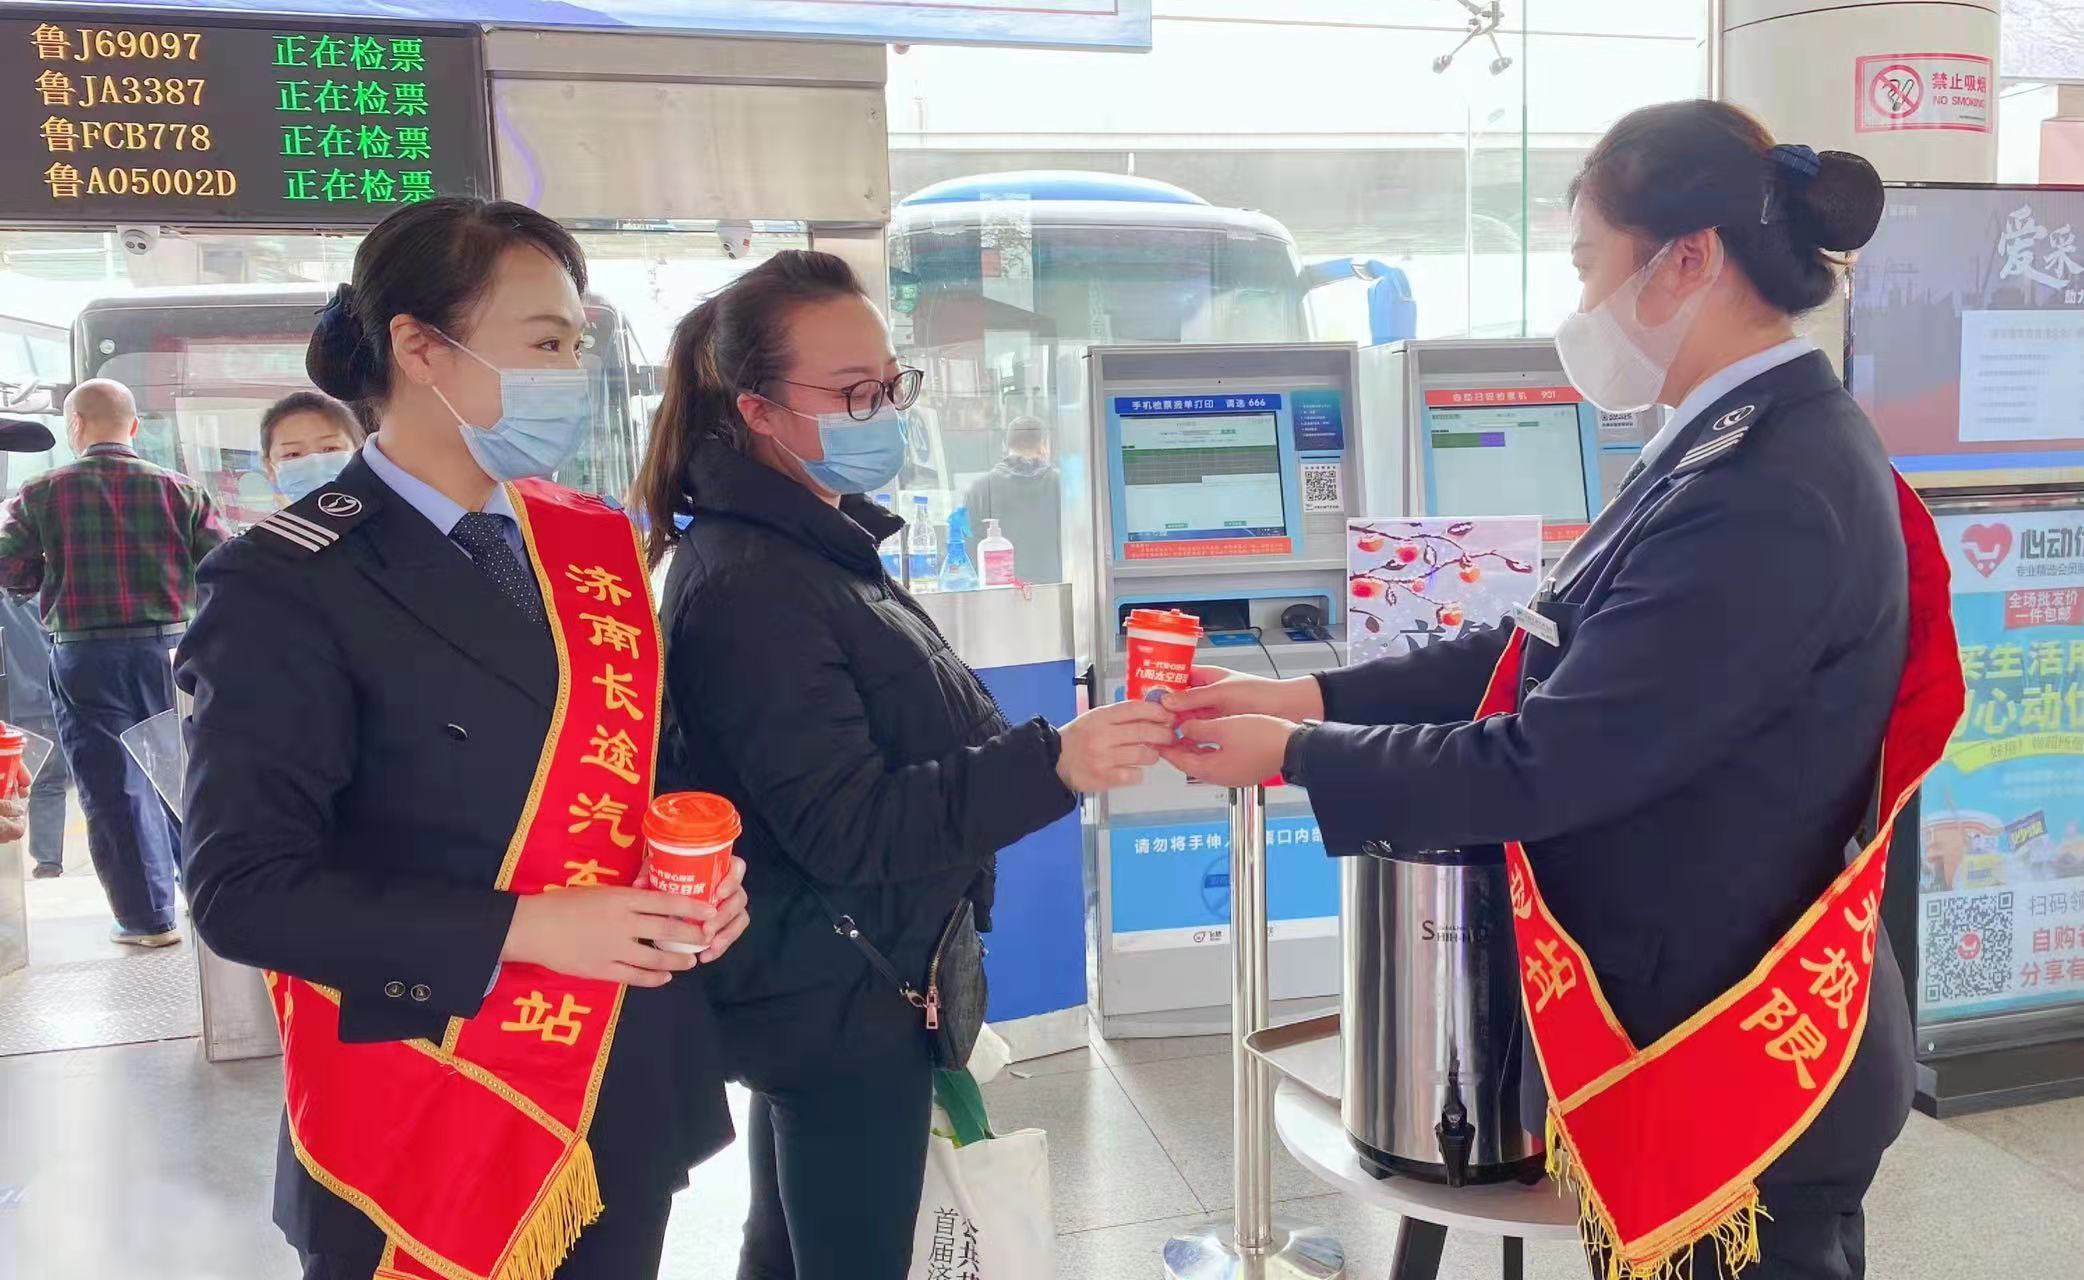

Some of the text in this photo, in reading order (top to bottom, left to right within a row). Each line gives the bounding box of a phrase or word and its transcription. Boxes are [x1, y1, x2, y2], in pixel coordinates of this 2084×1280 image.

[31, 22, 426, 73] 鲁J69097 正在检票
[34, 69, 430, 117] 鲁JA3387 正在检票
[1932, 72, 1987, 93] 禁止吸烟
[1932, 95, 1985, 109] NO SMOKING
[39, 115, 432, 161] 鲁FCB778 正在检票
[43, 161, 435, 204] 鲁A05002D 正在检票
[1248, 398, 1266, 407] 666
[2008, 590, 2079, 609] 全场批发价
[2015, 607, 2072, 624] 一件包邮
